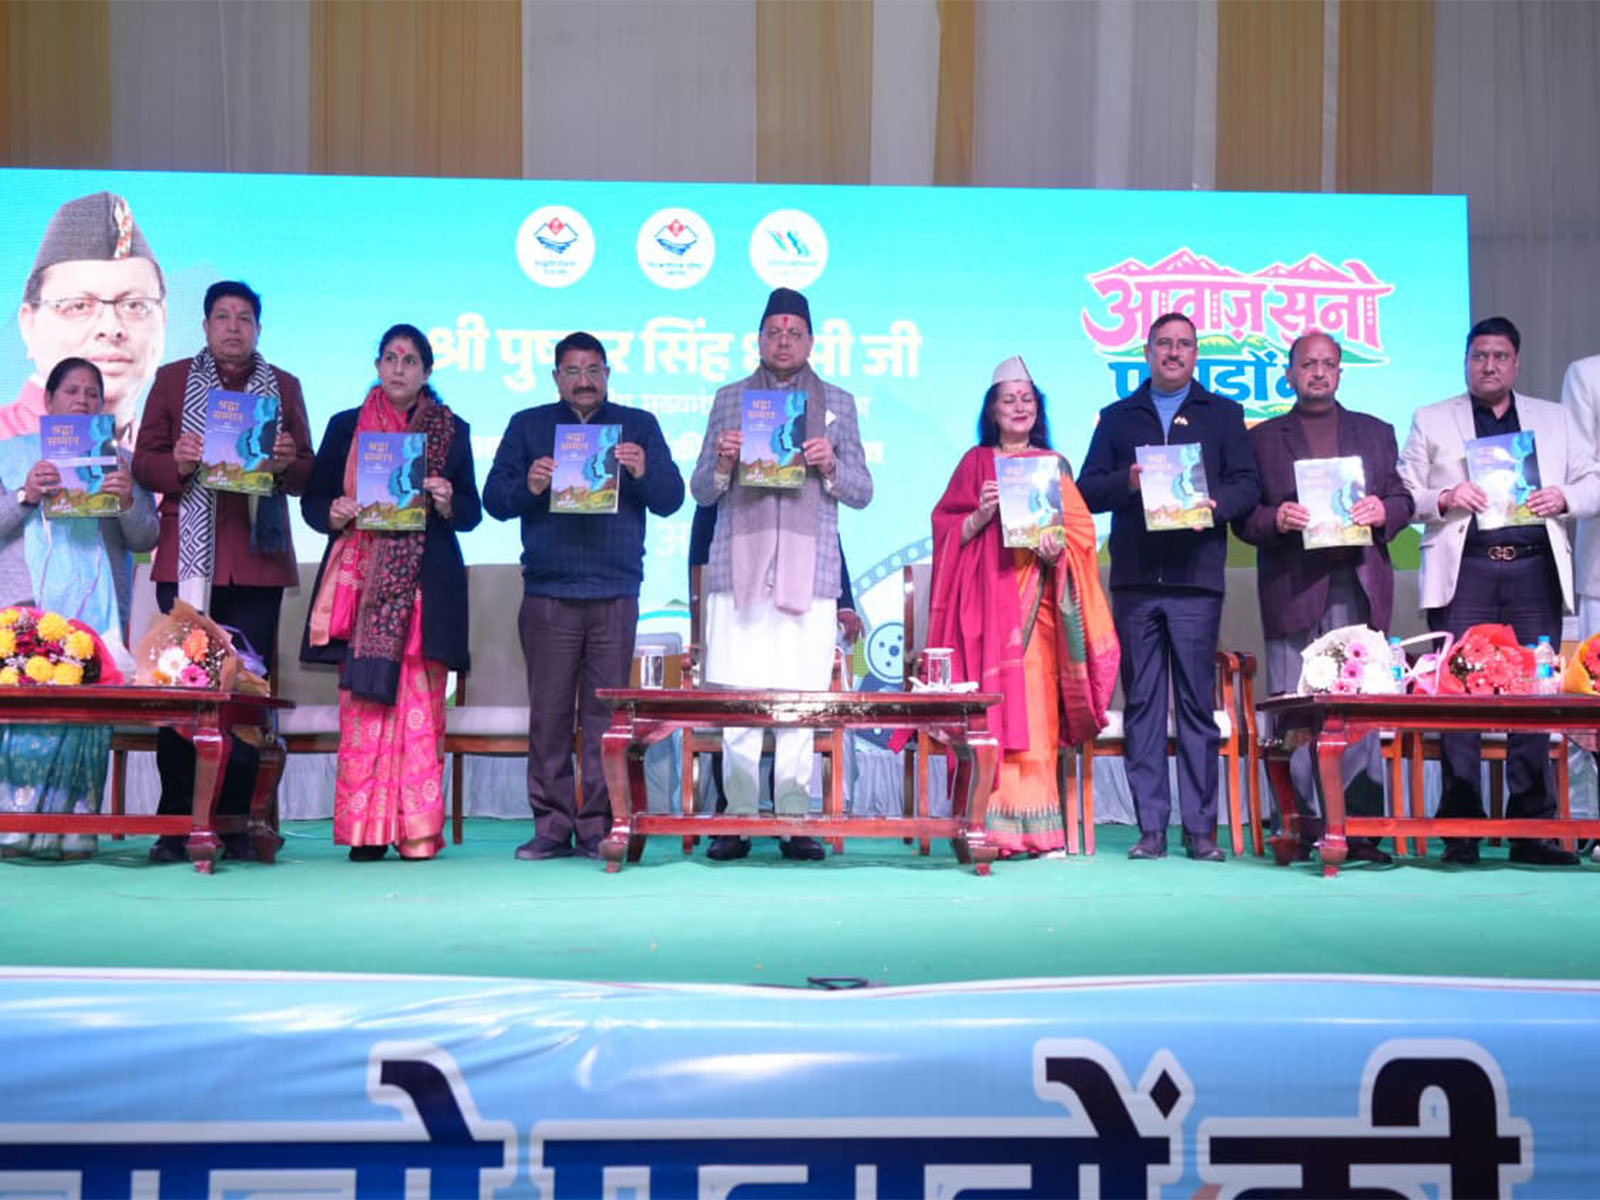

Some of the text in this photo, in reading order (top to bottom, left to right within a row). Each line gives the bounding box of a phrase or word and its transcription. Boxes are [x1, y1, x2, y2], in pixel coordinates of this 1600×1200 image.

[426, 311, 491, 374] श्री
[639, 317, 735, 383] सिंह
[861, 320, 924, 378] जी
[1082, 275, 1268, 348] आवाज़
